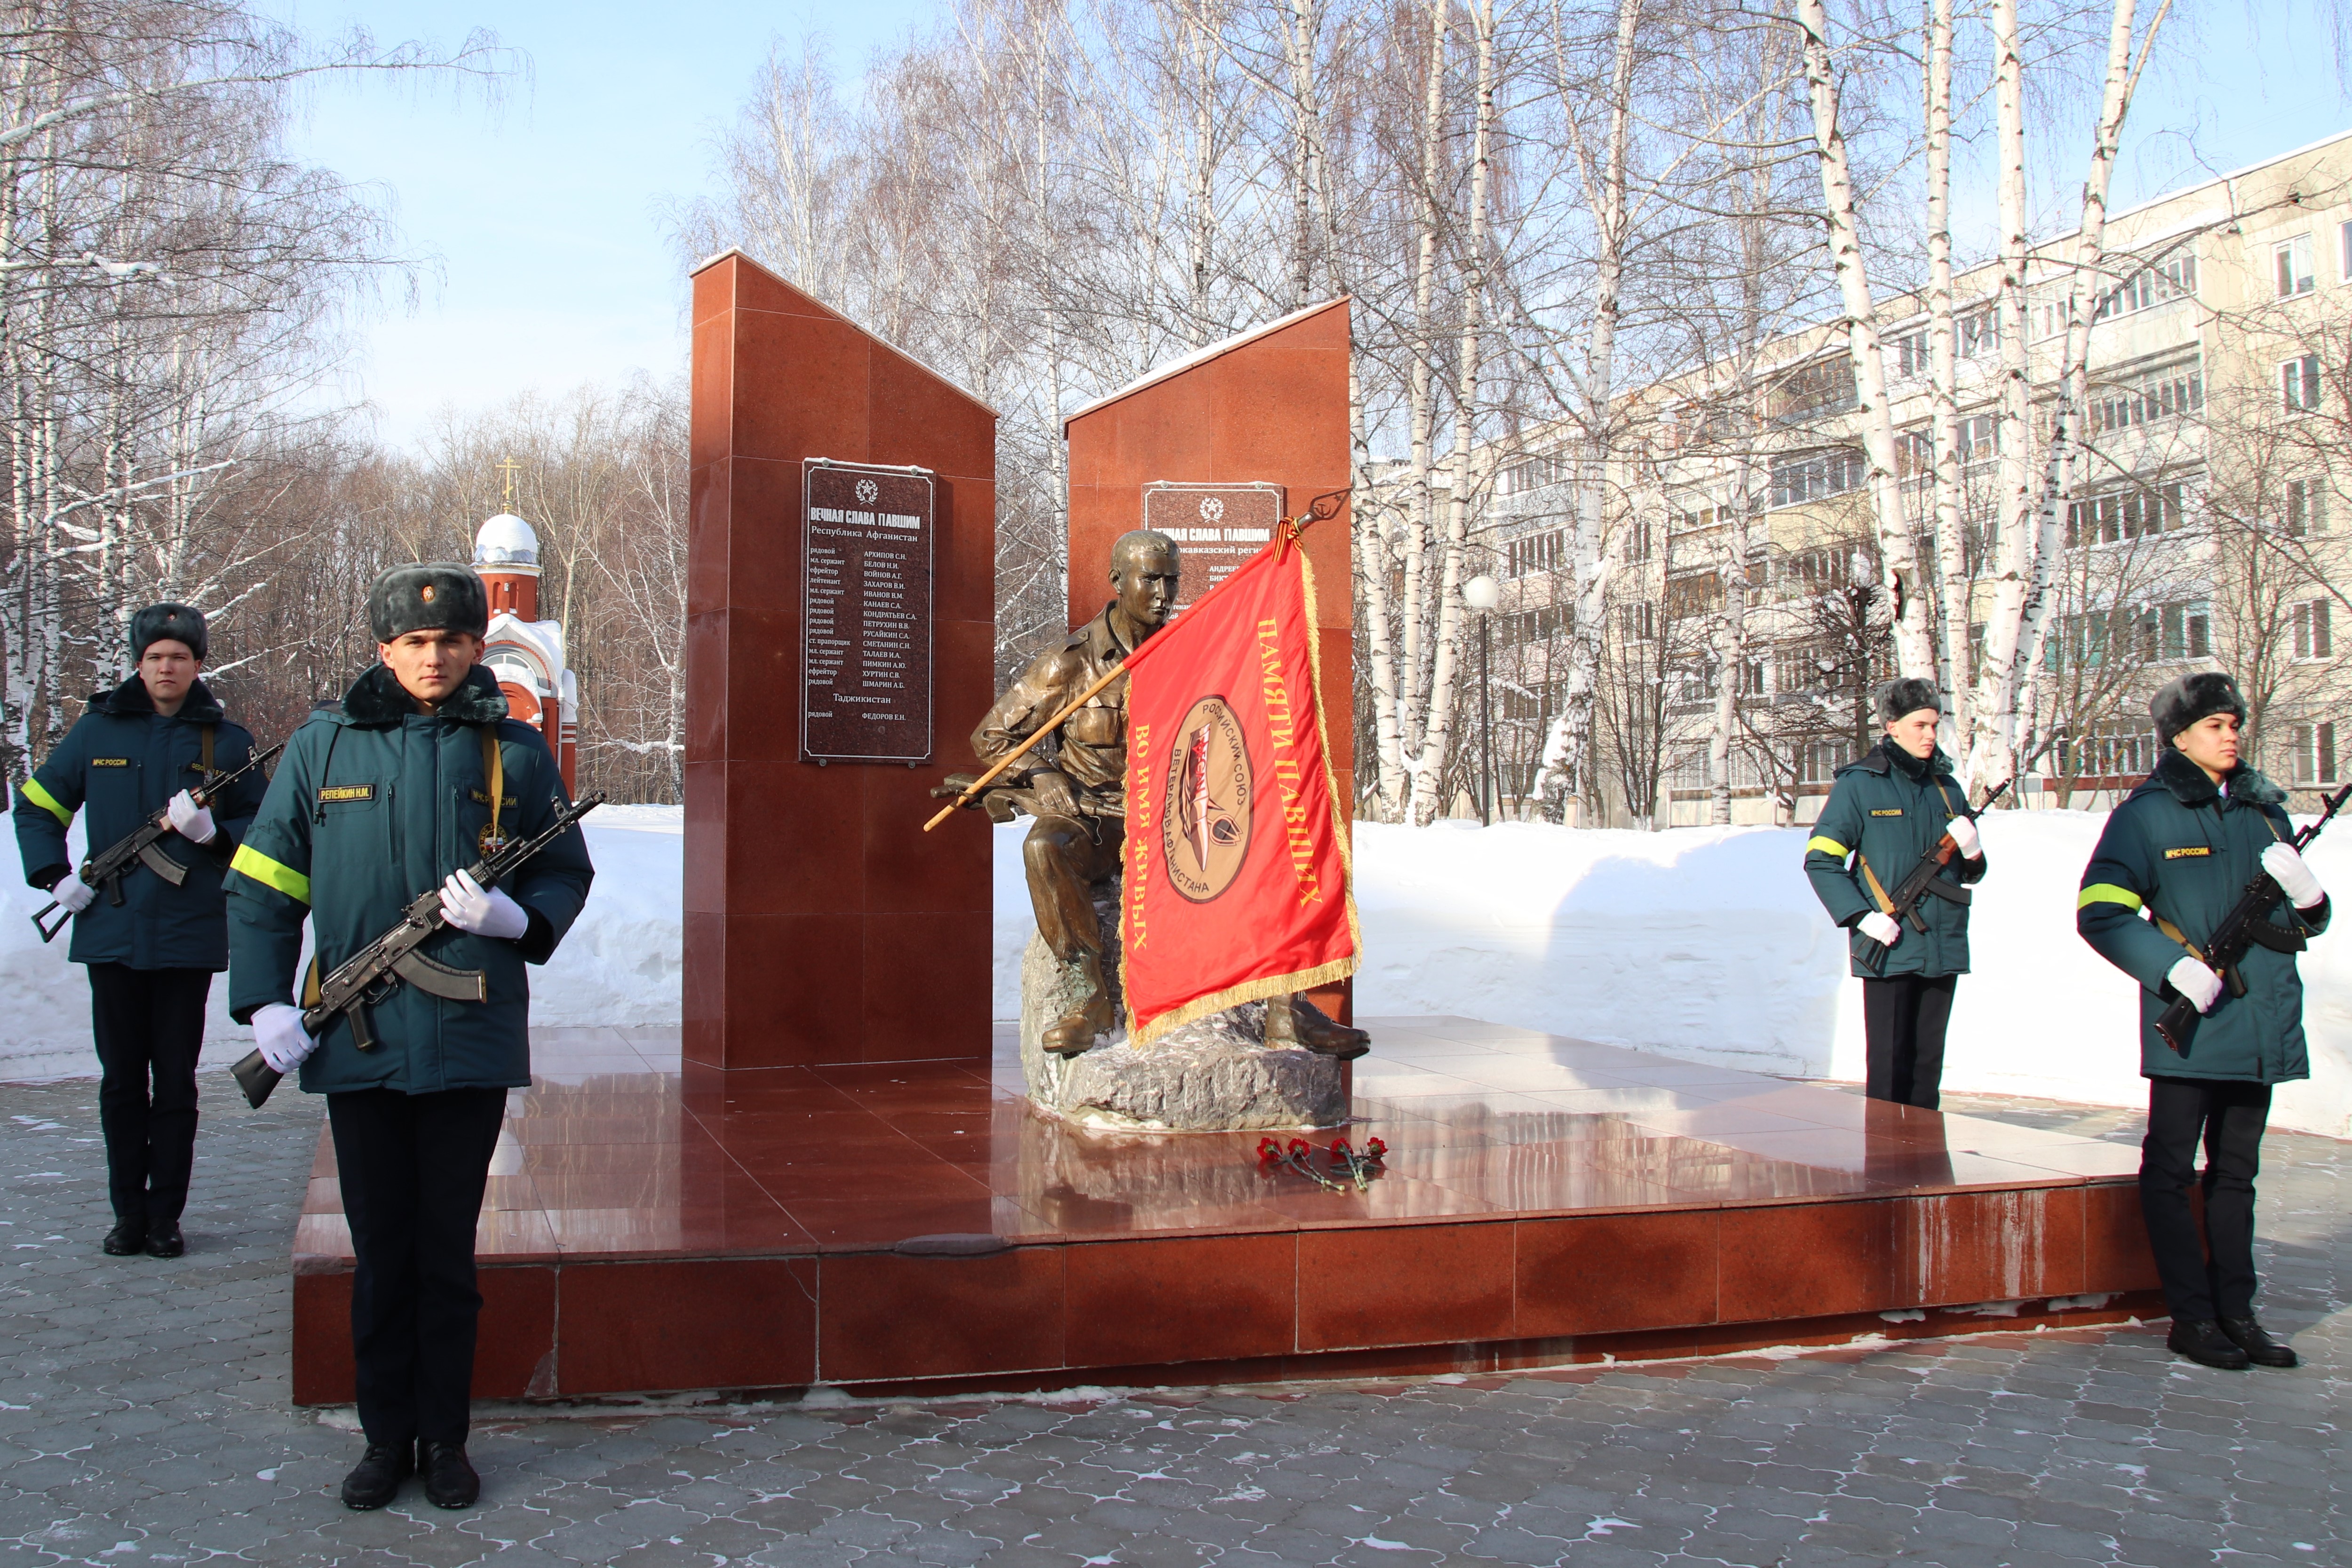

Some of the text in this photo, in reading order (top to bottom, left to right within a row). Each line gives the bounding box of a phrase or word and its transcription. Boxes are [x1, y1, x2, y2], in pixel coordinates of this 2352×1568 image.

[810, 508, 920, 529] ВЕЧНАЯ СЛАВА ПАВШИМ
[812, 526, 917, 541] Республика Афганистан
[1189, 528, 1221, 541] СЛАВА
[1224, 528, 1270, 541] ПАВШИМ
[863, 611, 905, 619] КОНДРАТЬЕВ
[833, 693, 891, 704] Таджикистан
[1203, 704, 1246, 806] РОССИЙСКИЙ СОЮЗ
[1258, 617, 1323, 908] ПАМЯТИ ПАВШИХ
[321, 787, 369, 800] РЕПЕЙКИН Н.М.
[485, 796, 516, 806] РСИИ
[1164, 748, 1209, 893] ВЕТЕРАНОВ АФГАНИСТАНА
[1132, 723, 1150, 951] ВО ИМЯ ЖИВЫХ
[2165, 847, 2209, 858] МЧС РОССИИ
